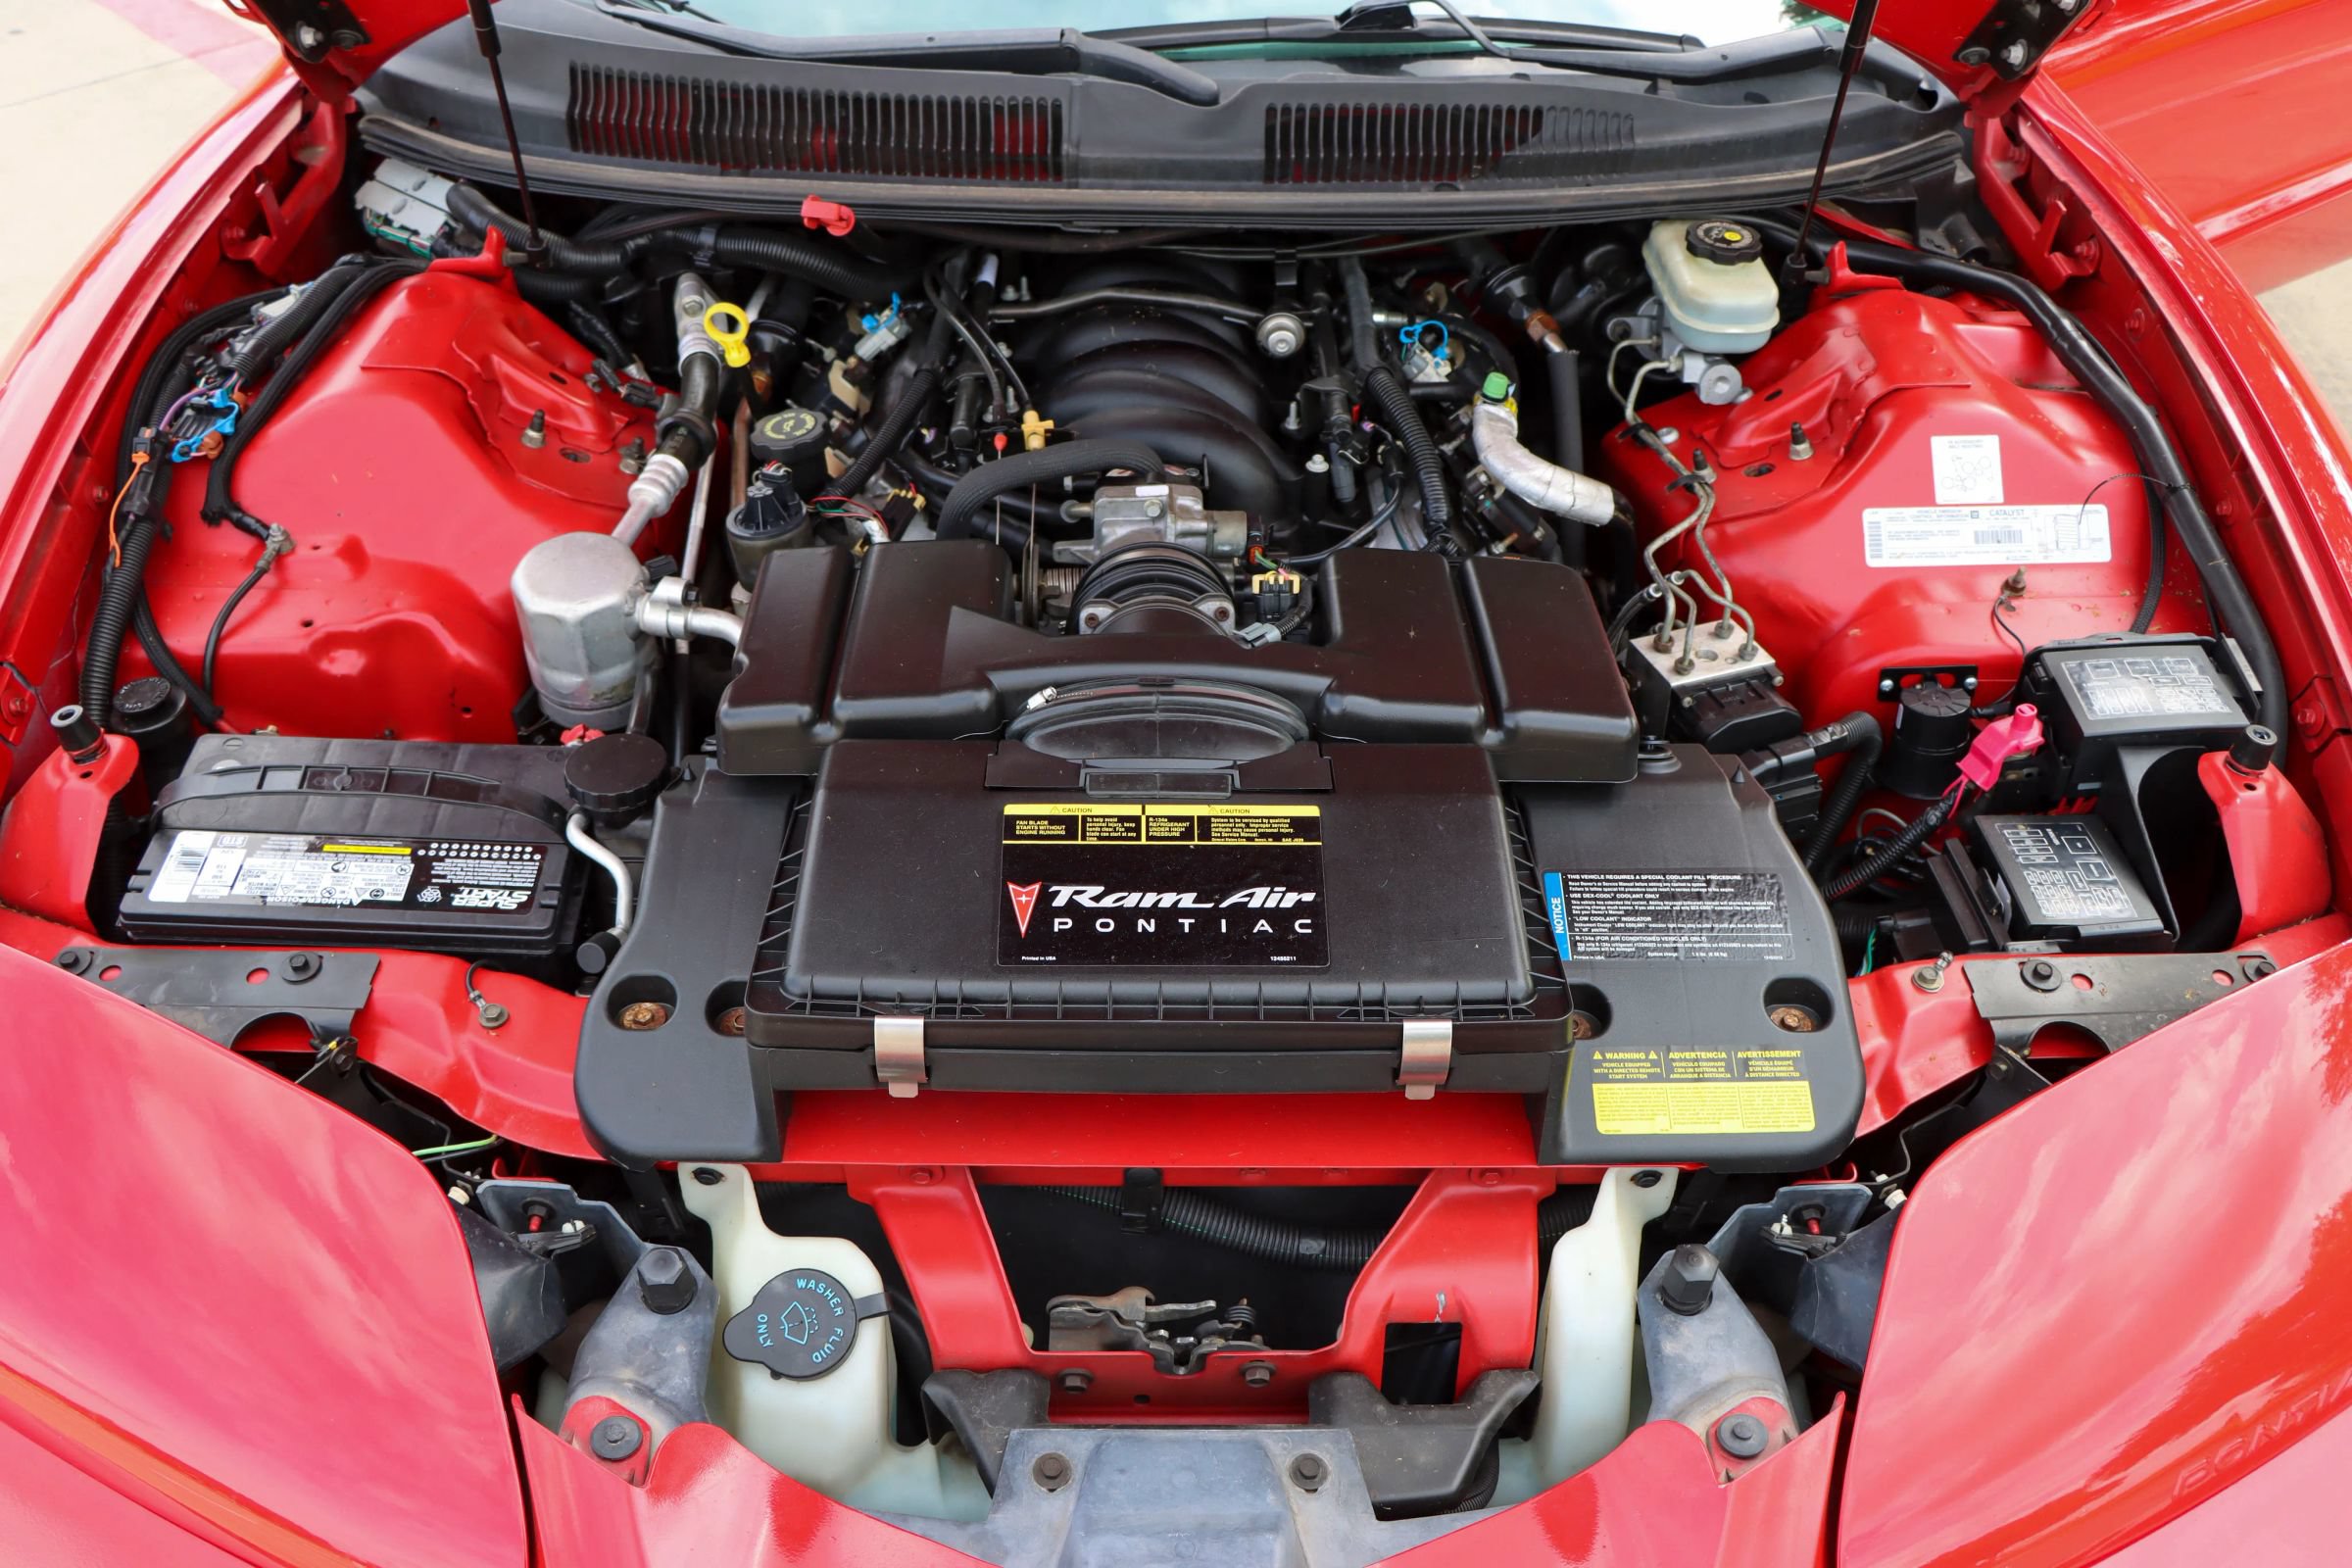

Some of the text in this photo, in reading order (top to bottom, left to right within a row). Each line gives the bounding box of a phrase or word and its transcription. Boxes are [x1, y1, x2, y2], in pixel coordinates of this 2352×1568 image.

[266, 896, 351, 905] DANGER/POISON
[451, 897, 518, 910] SUPER
[454, 889, 532, 902] START
[1048, 886, 1317, 907] Ram Air
[1053, 918, 1312, 933] PONTIAC
[1551, 897, 1565, 933] NOTICE
[796, 1278, 845, 1317] WASHER
[756, 1314, 774, 1348] ONLY
[812, 1327, 844, 1363] FLUID
